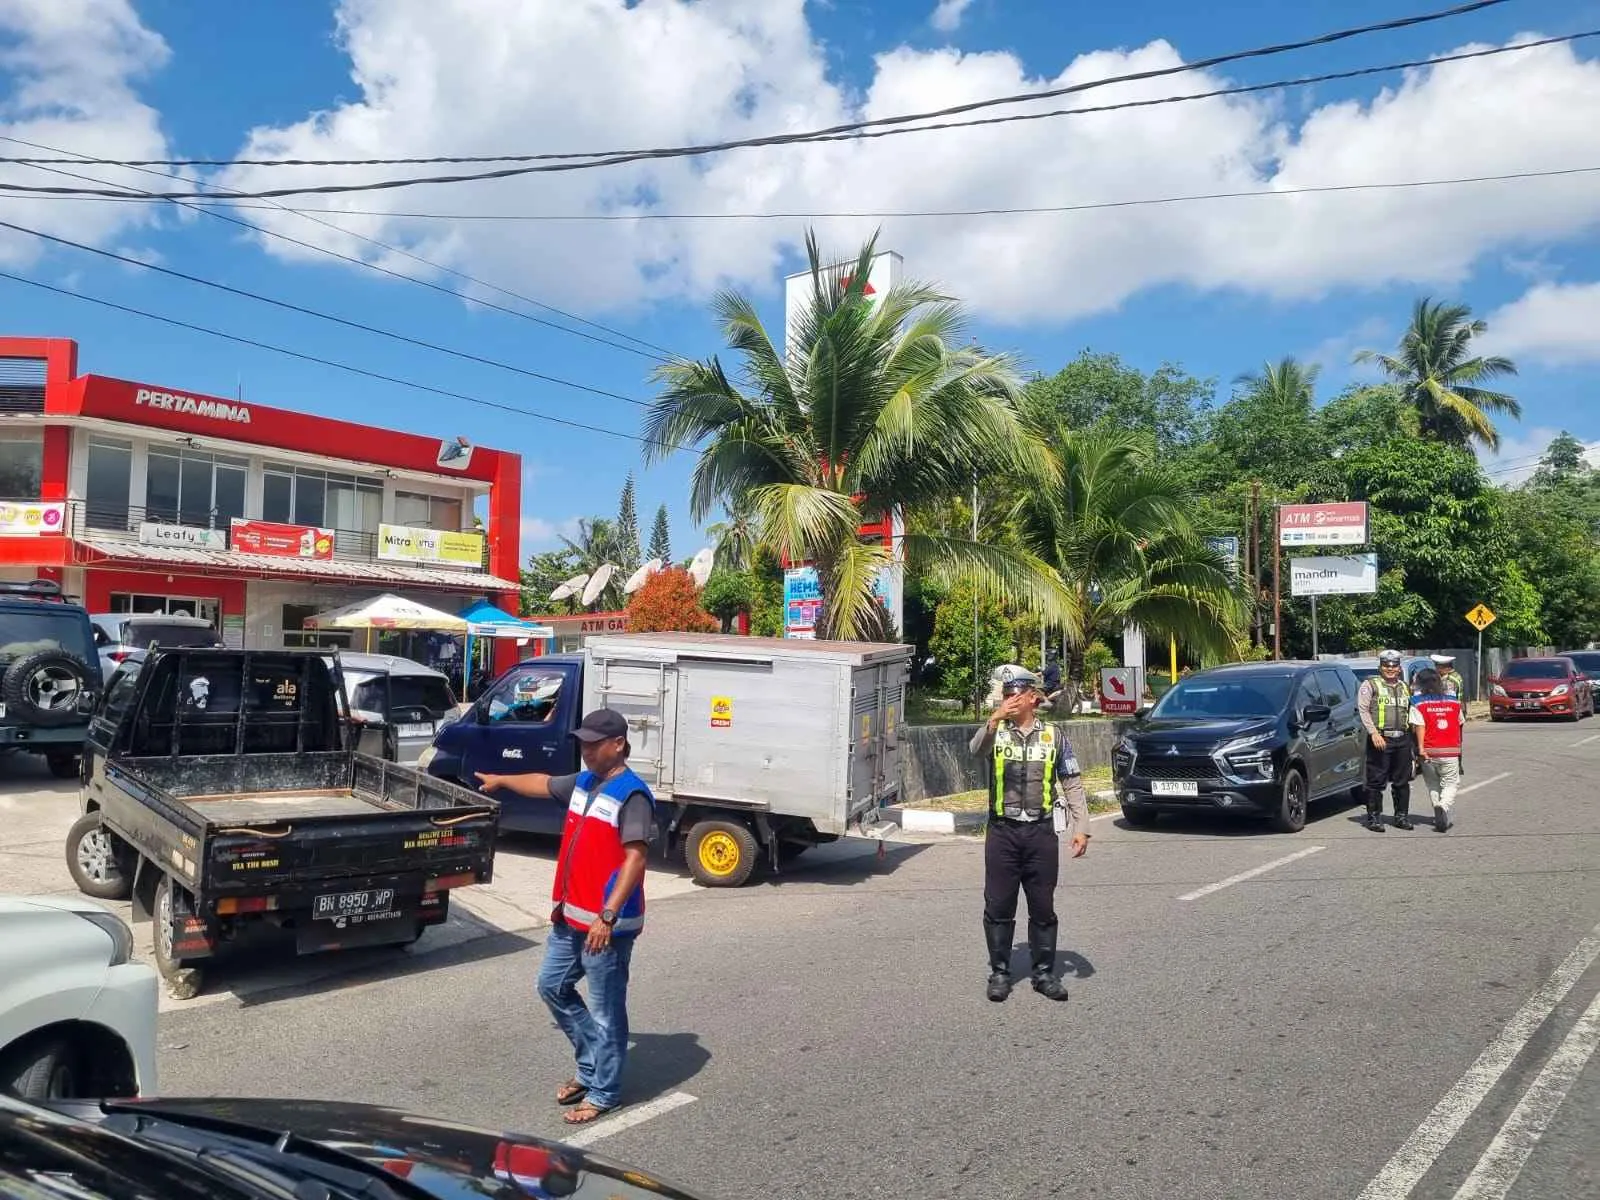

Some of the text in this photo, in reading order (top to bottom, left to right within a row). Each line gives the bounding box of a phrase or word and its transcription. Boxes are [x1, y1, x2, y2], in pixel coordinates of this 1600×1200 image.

[136, 389, 251, 423] PERTAMINA
[1284, 512, 1311, 525] ATM
[156, 527, 194, 542] Leafy
[384, 535, 411, 547] Mitra
[581, 620, 604, 633] ATM
[1105, 703, 1132, 711] KELUAR
[339, 893, 369, 910] 8950
